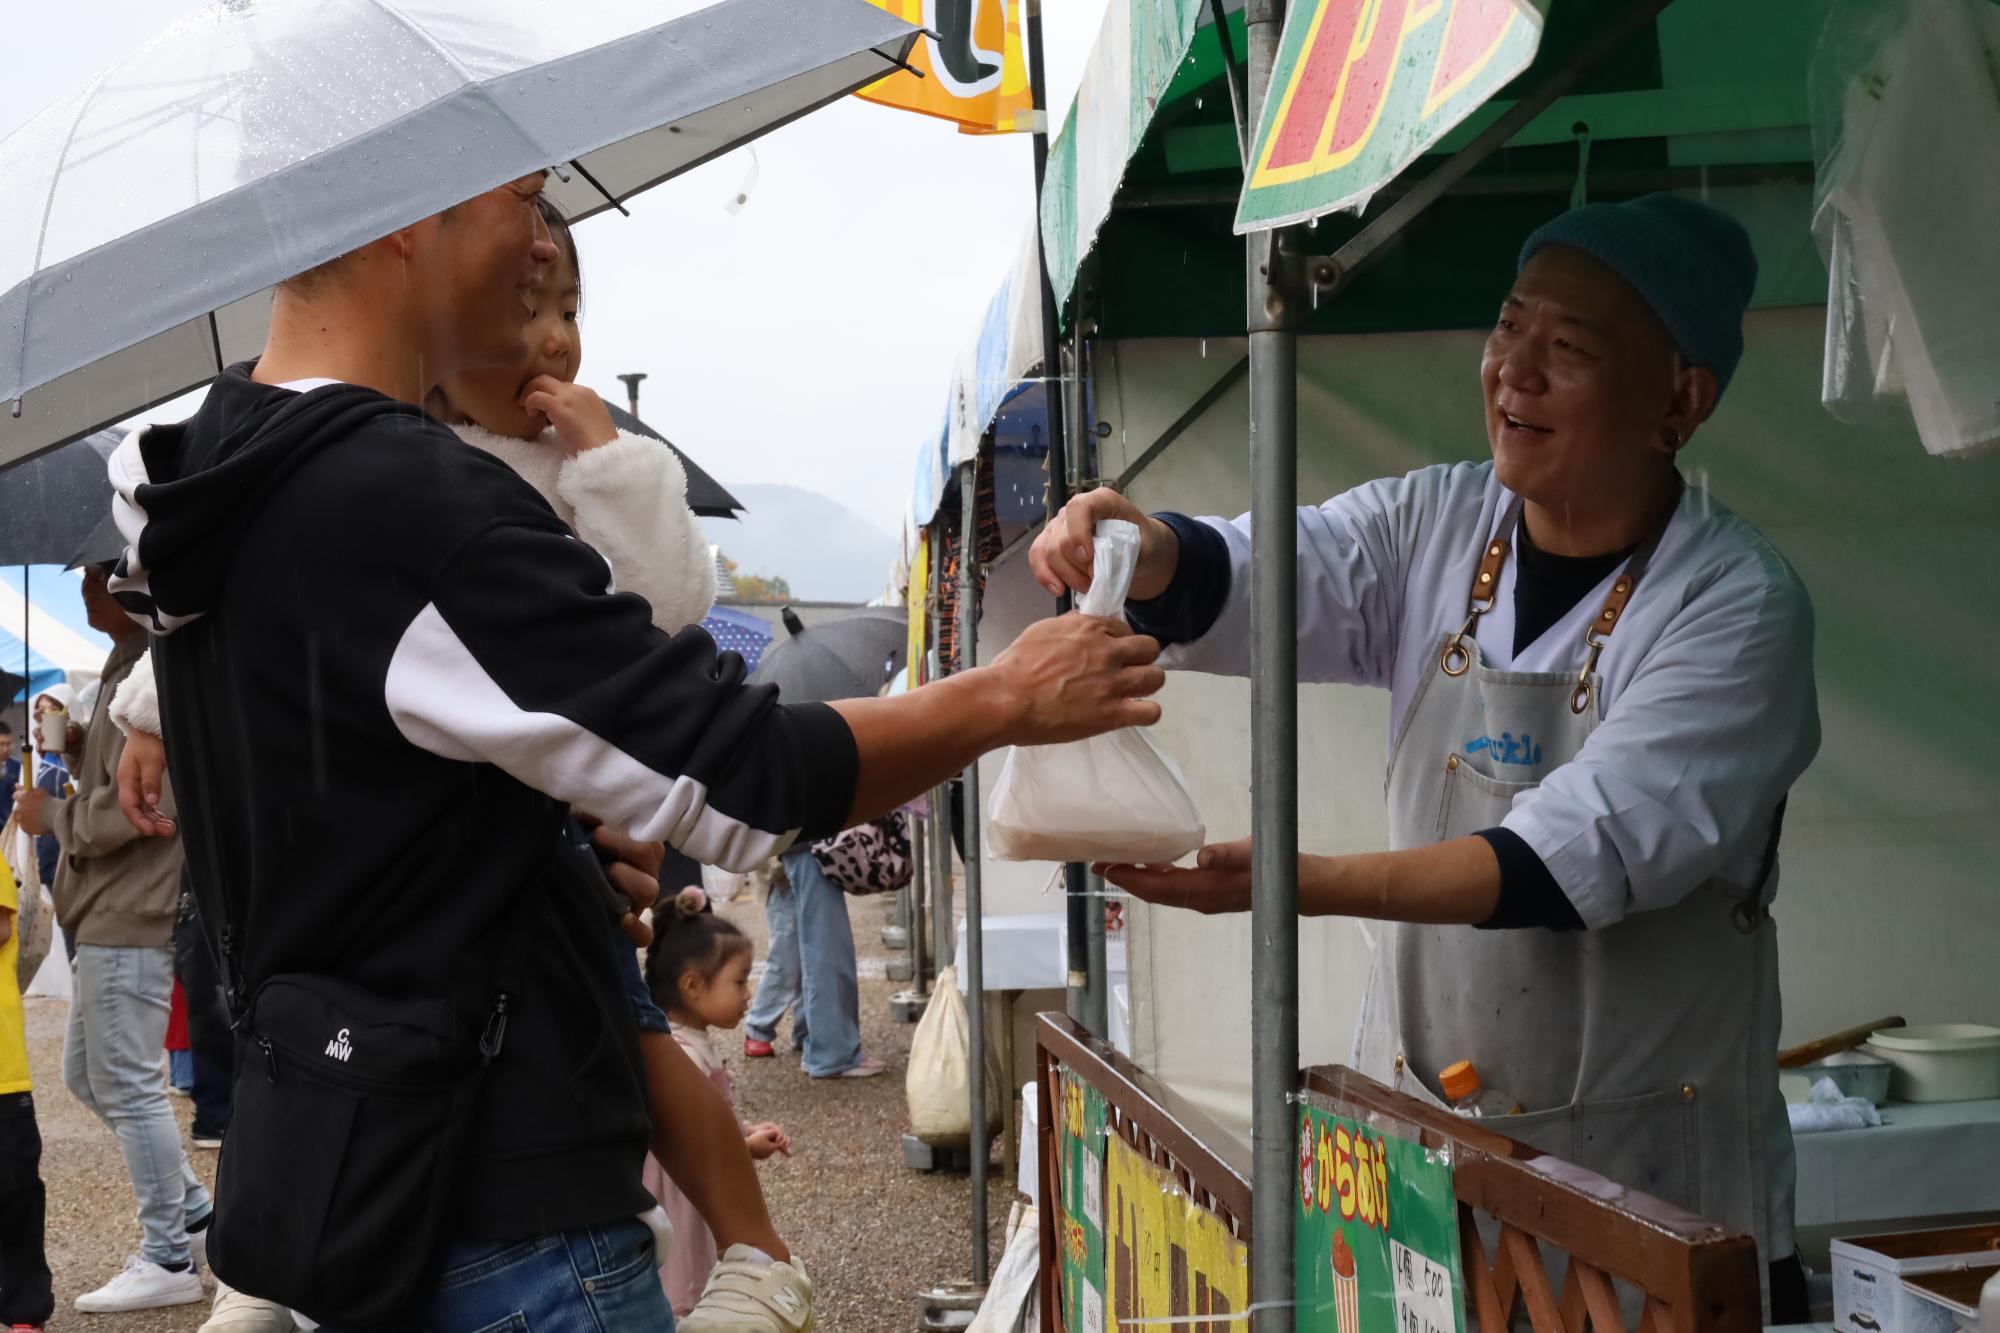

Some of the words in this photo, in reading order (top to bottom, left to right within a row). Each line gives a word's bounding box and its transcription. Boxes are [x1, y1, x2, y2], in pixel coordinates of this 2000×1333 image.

[1317, 1119, 1389, 1232] からあげ
[1424, 1259, 1443, 1297] 500
